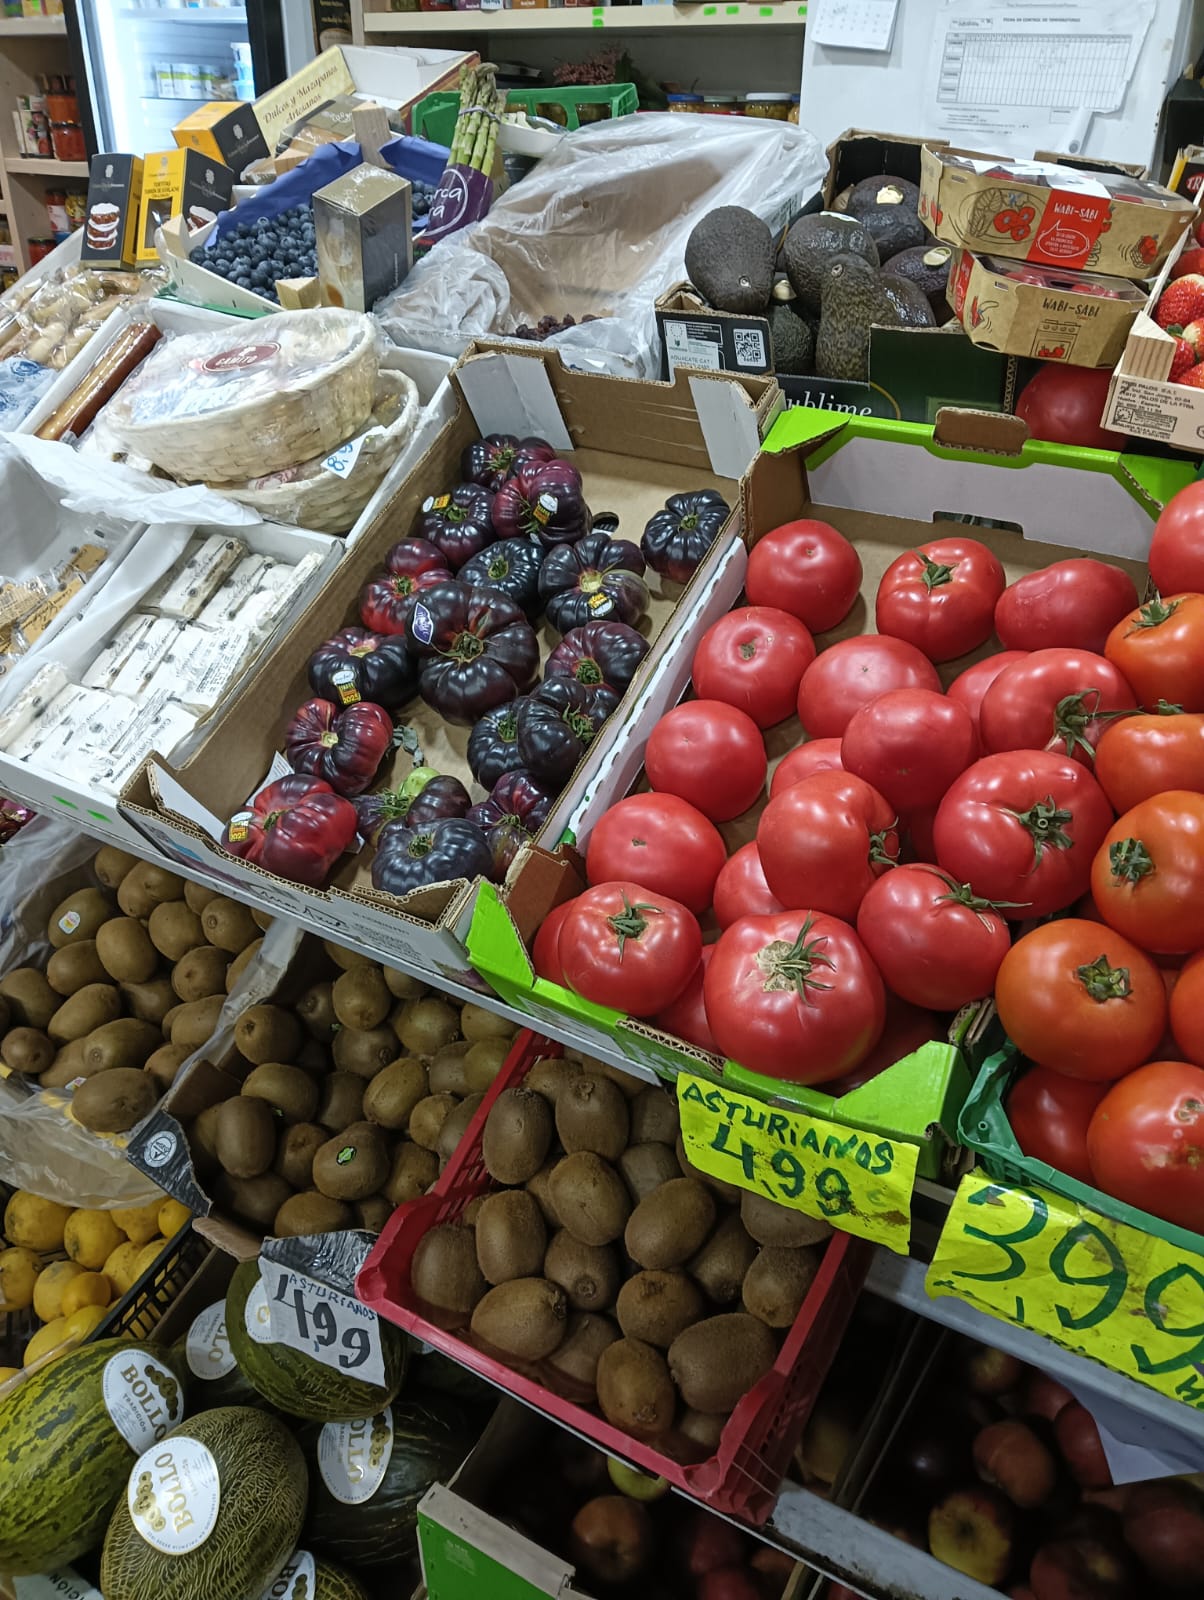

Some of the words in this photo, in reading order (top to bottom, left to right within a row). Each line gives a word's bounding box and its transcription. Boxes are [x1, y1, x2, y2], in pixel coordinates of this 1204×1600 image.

[1054, 202, 1099, 220] WABI-SABI
[1042, 297, 1101, 318] WABI-SABI
[682, 1082, 894, 1176] ASTURIANOS
[289, 1274, 377, 1321] ASTURIANOS
[120, 1362, 167, 1442] BOLLO
[122, 1392, 147, 1434] TRADICIÓN
[347, 1419, 367, 1485] OLLO
[154, 1452, 195, 1533] BOLLO
